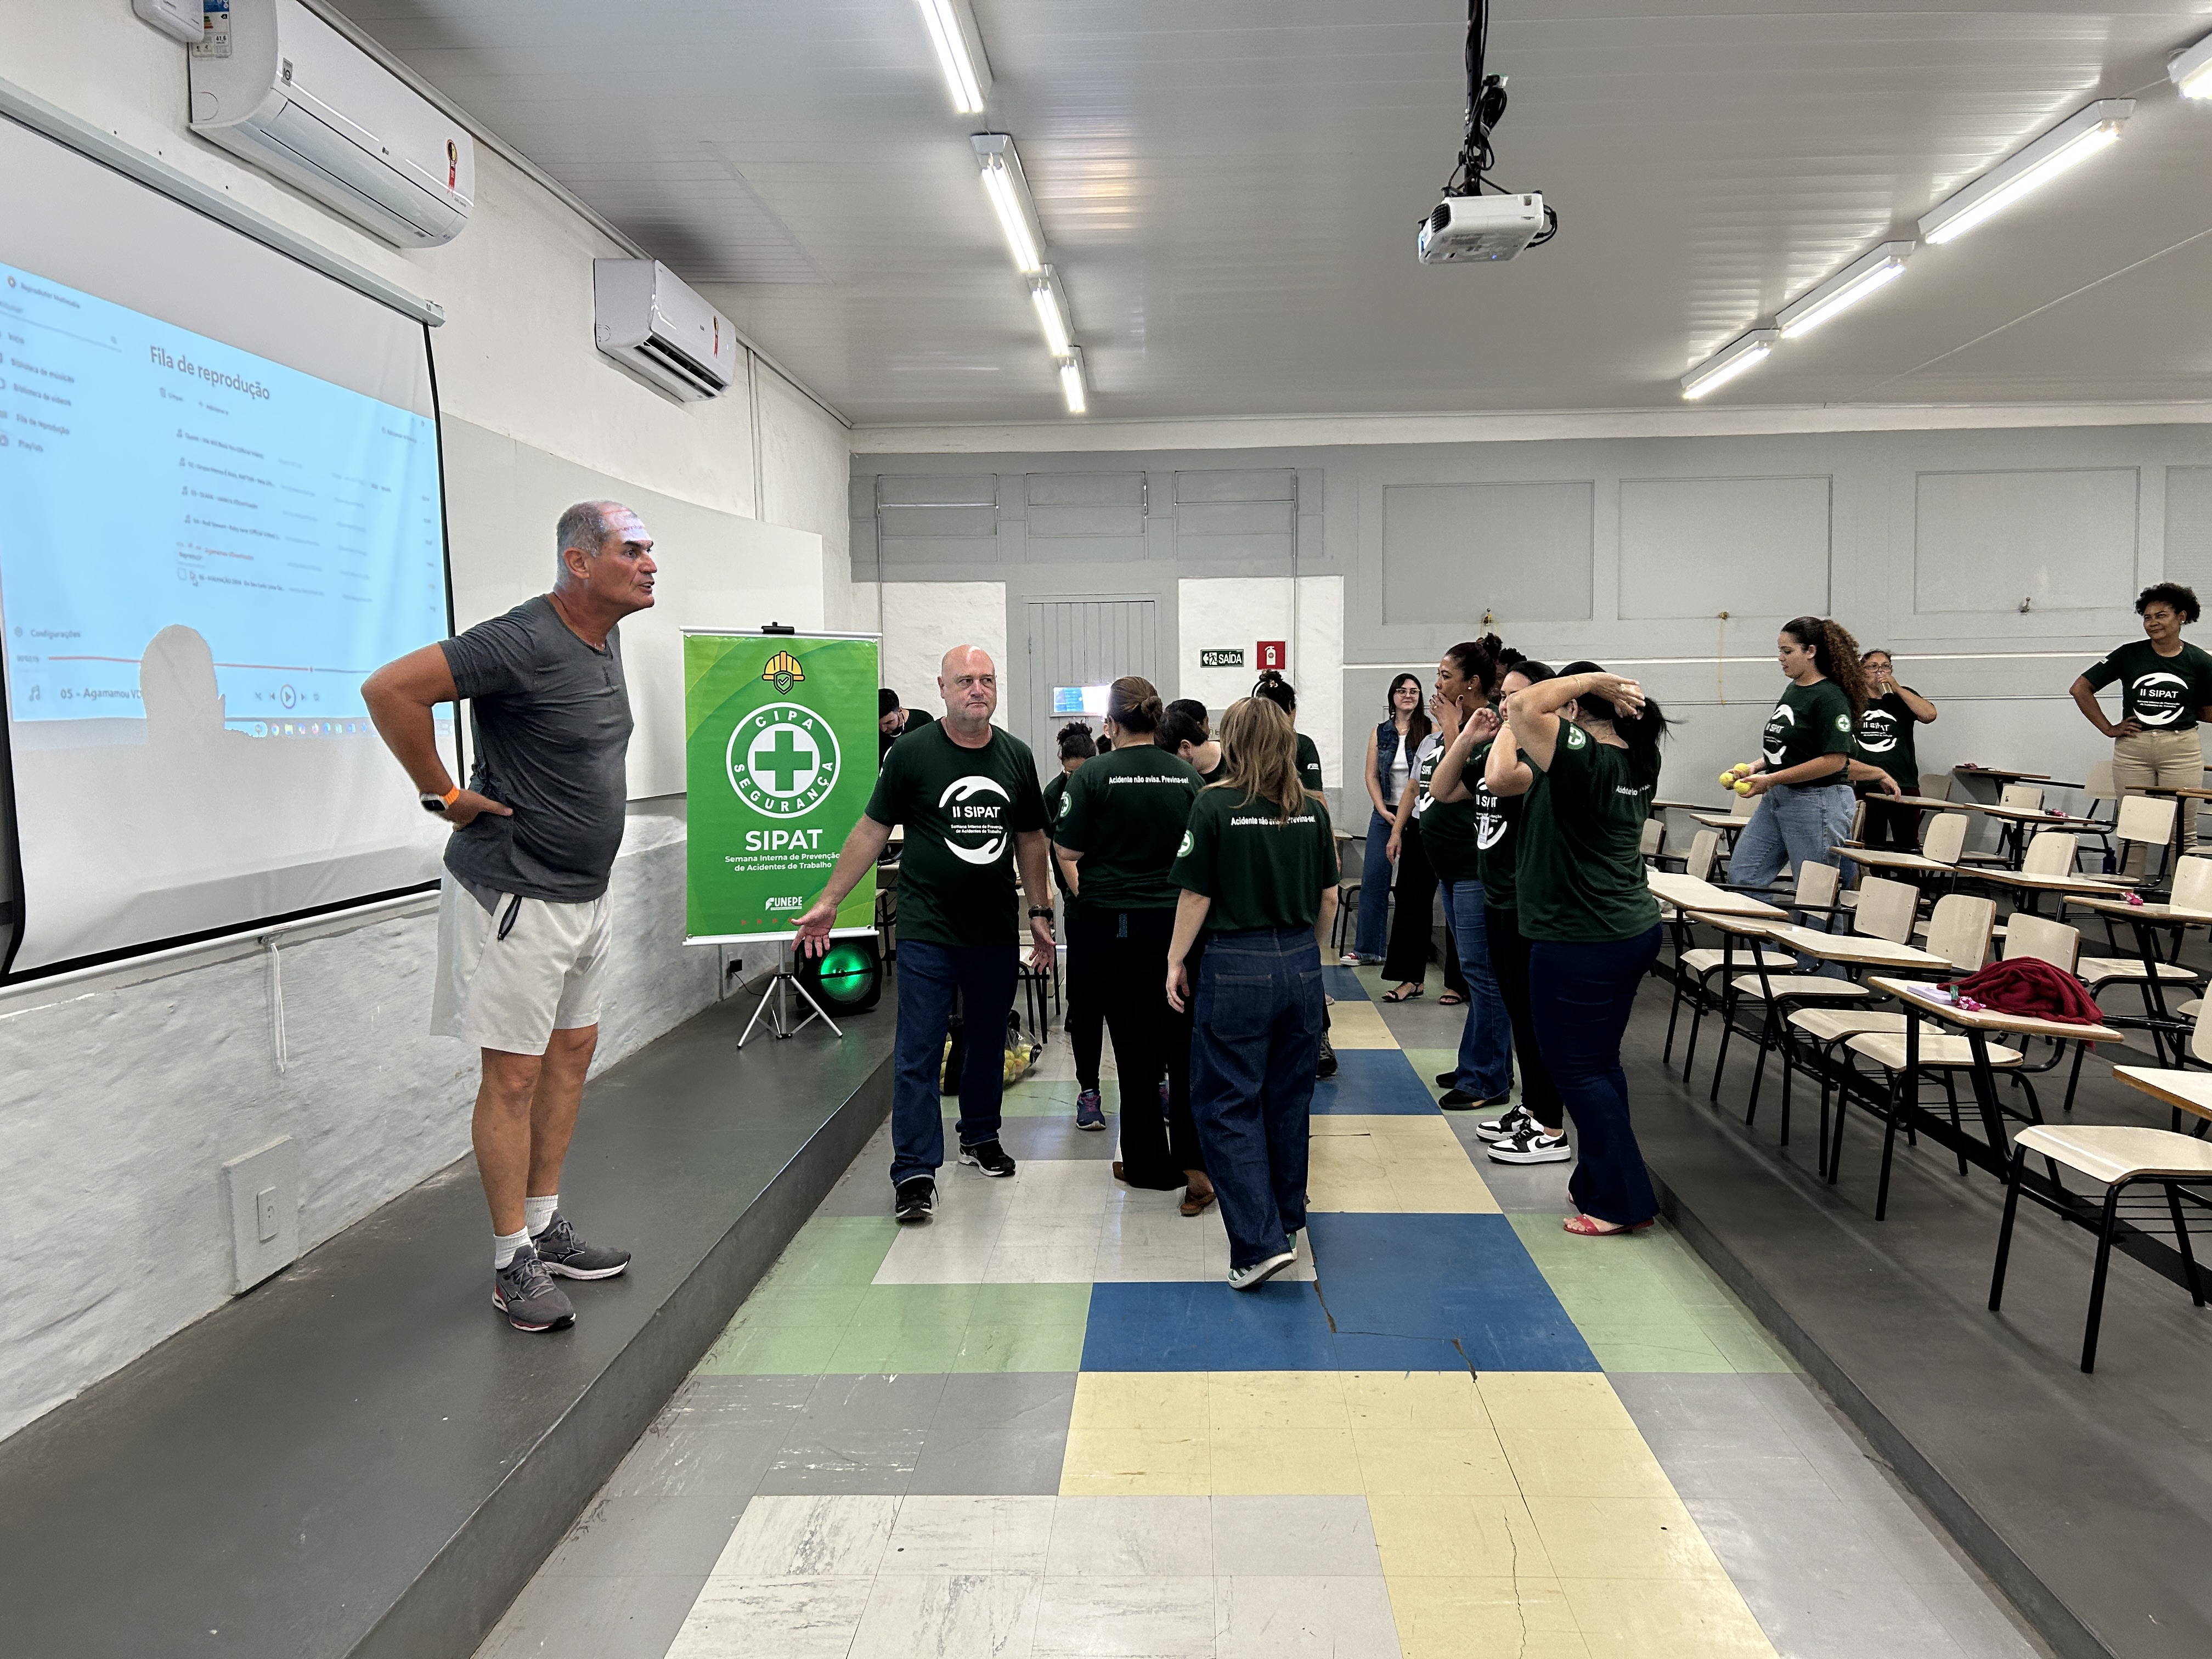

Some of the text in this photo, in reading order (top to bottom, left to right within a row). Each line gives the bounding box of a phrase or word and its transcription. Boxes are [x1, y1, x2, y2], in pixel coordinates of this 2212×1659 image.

[150, 345, 270, 400] Fila de reprodução
[31, 629, 81, 640] Configurações
[1218, 652, 1242, 664] SAÍDA
[60, 689, 73, 699] 05
[83, 689, 130, 701] Agamamou
[2149, 689, 2179, 698] SIPAT
[755, 710, 813, 730] CIPA
[1109, 776, 1133, 785] Acidente
[1133, 775, 1144, 783] não
[1145, 775, 1161, 783] avisa.
[734, 762, 833, 812] SEGURANÇA
[952, 806, 1001, 818] II SIPAT
[1231, 817, 1258, 826] Acidente
[1259, 817, 1268, 825] não
[745, 829, 823, 851] SIPAT
[725, 855, 758, 863] Semana
[802, 851, 840, 861] Prevenção
[747, 863, 786, 871] Acidentes
